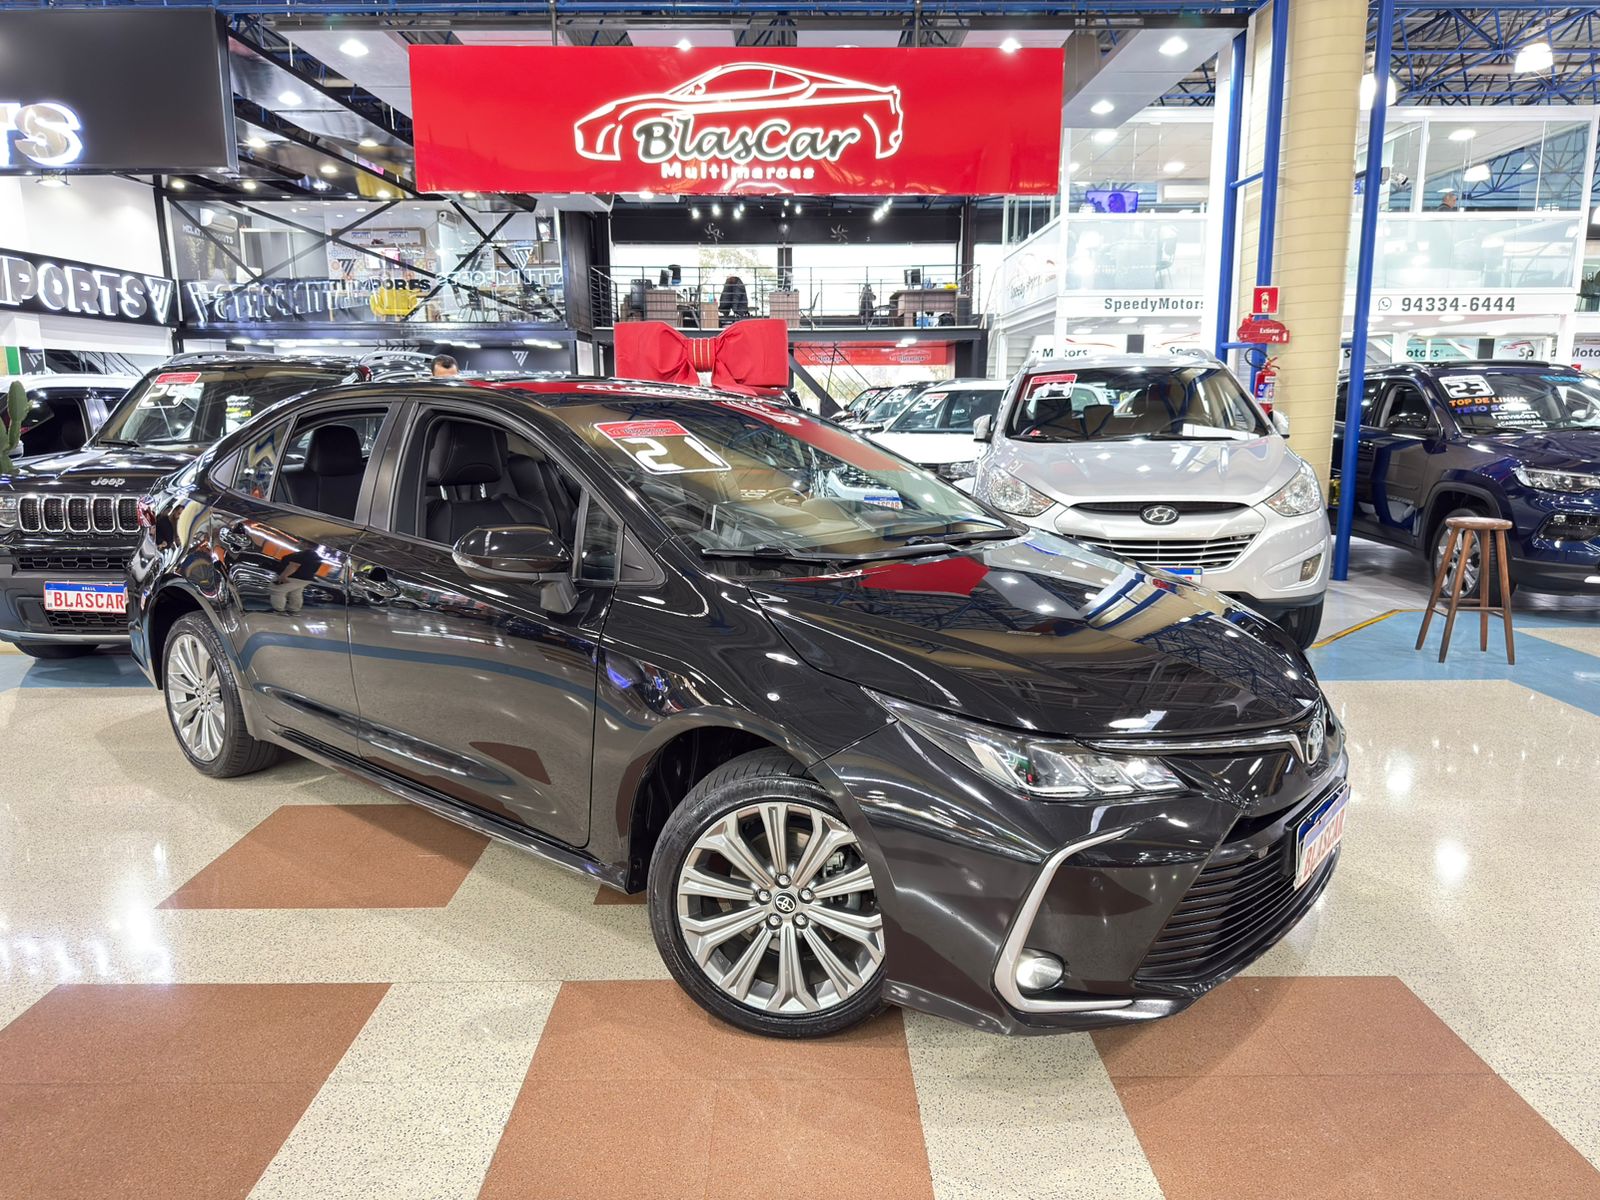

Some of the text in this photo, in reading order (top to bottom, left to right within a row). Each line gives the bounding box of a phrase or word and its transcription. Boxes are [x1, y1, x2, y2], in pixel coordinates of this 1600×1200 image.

[632, 113, 861, 164] BlasCar
[1401, 297, 1516, 312] 94334-6444
[1446, 381, 1486, 396] 23
[1455, 406, 1487, 414] TETO
[621, 437, 724, 471] 21
[90, 477, 126, 488] Jeep
[54, 592, 124, 609] BLASCAR
